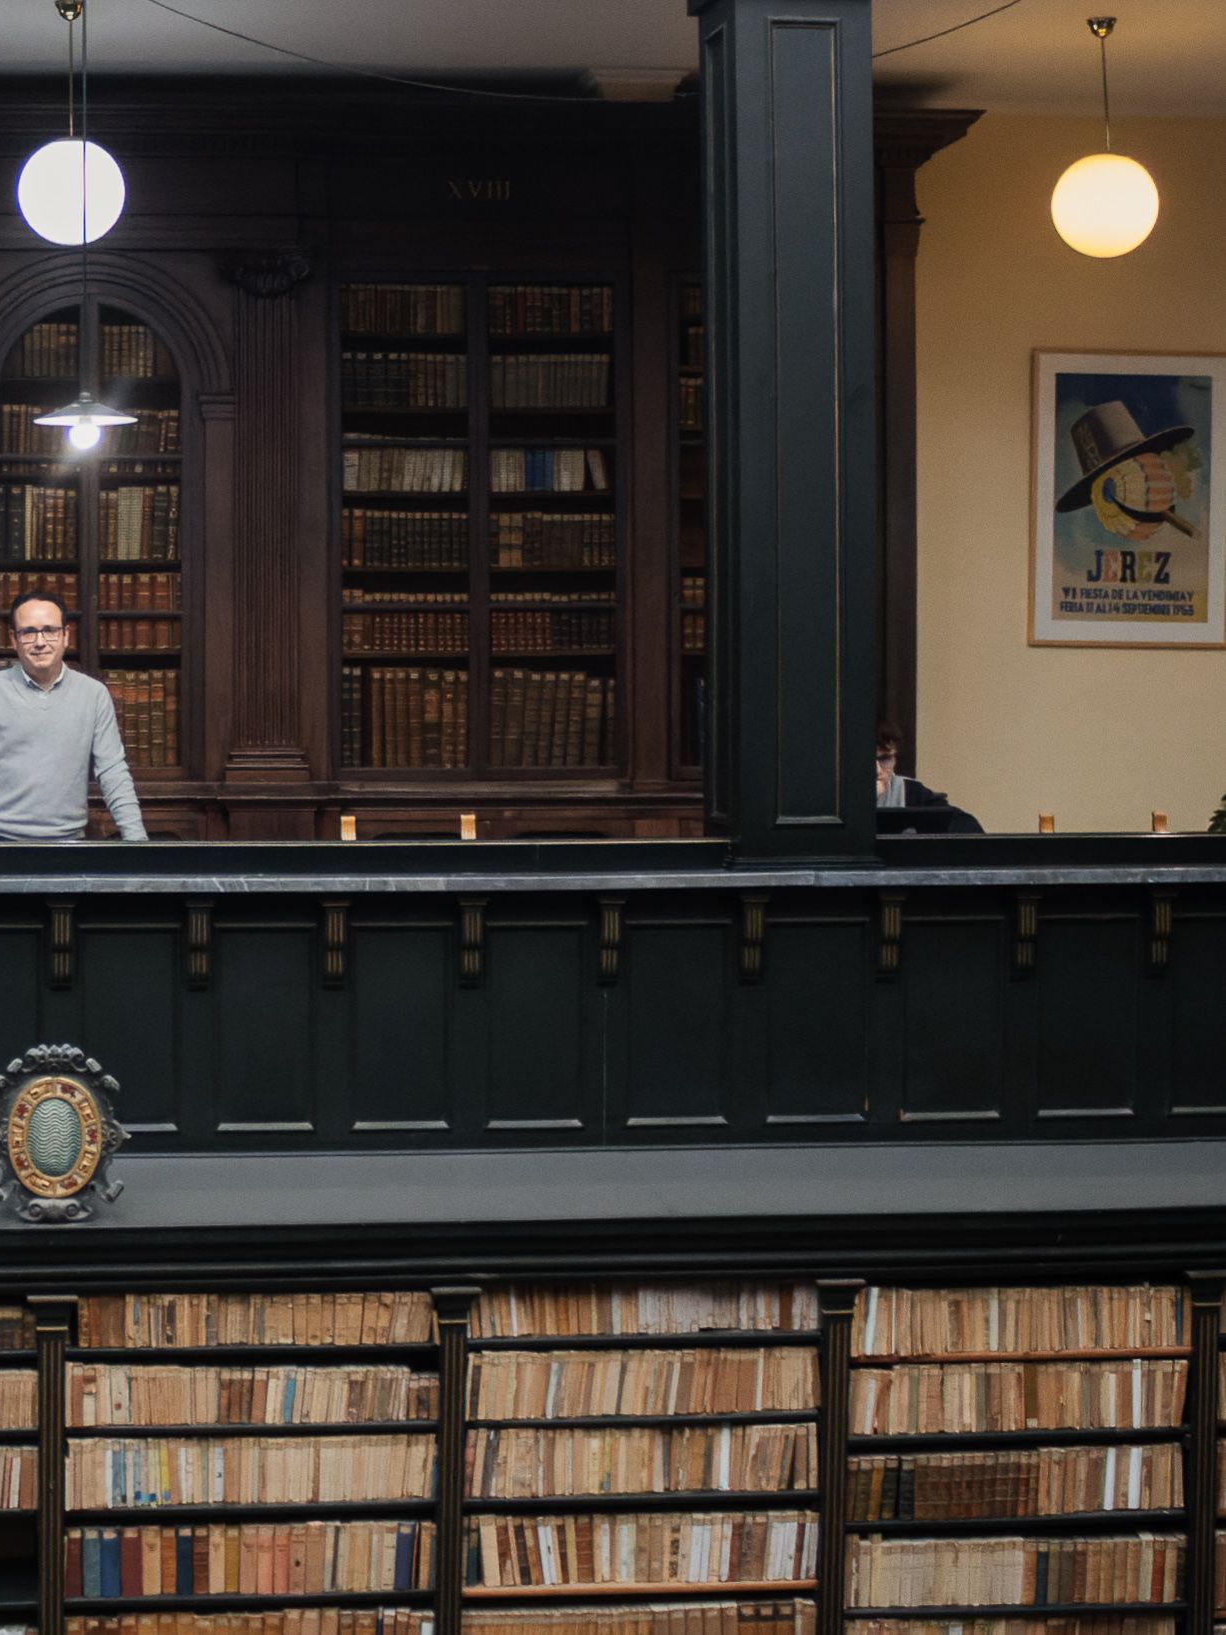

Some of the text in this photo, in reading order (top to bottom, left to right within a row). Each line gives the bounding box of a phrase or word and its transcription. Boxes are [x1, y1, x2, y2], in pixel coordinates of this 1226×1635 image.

[1087, 549, 1172, 584] JEREZ
[1080, 588, 1110, 600] FIESTA
[1111, 589, 1124, 600] DE
[1126, 589, 1139, 601] LA
[1060, 601, 1084, 613] FERIA
[1095, 602, 1107, 614] AL
